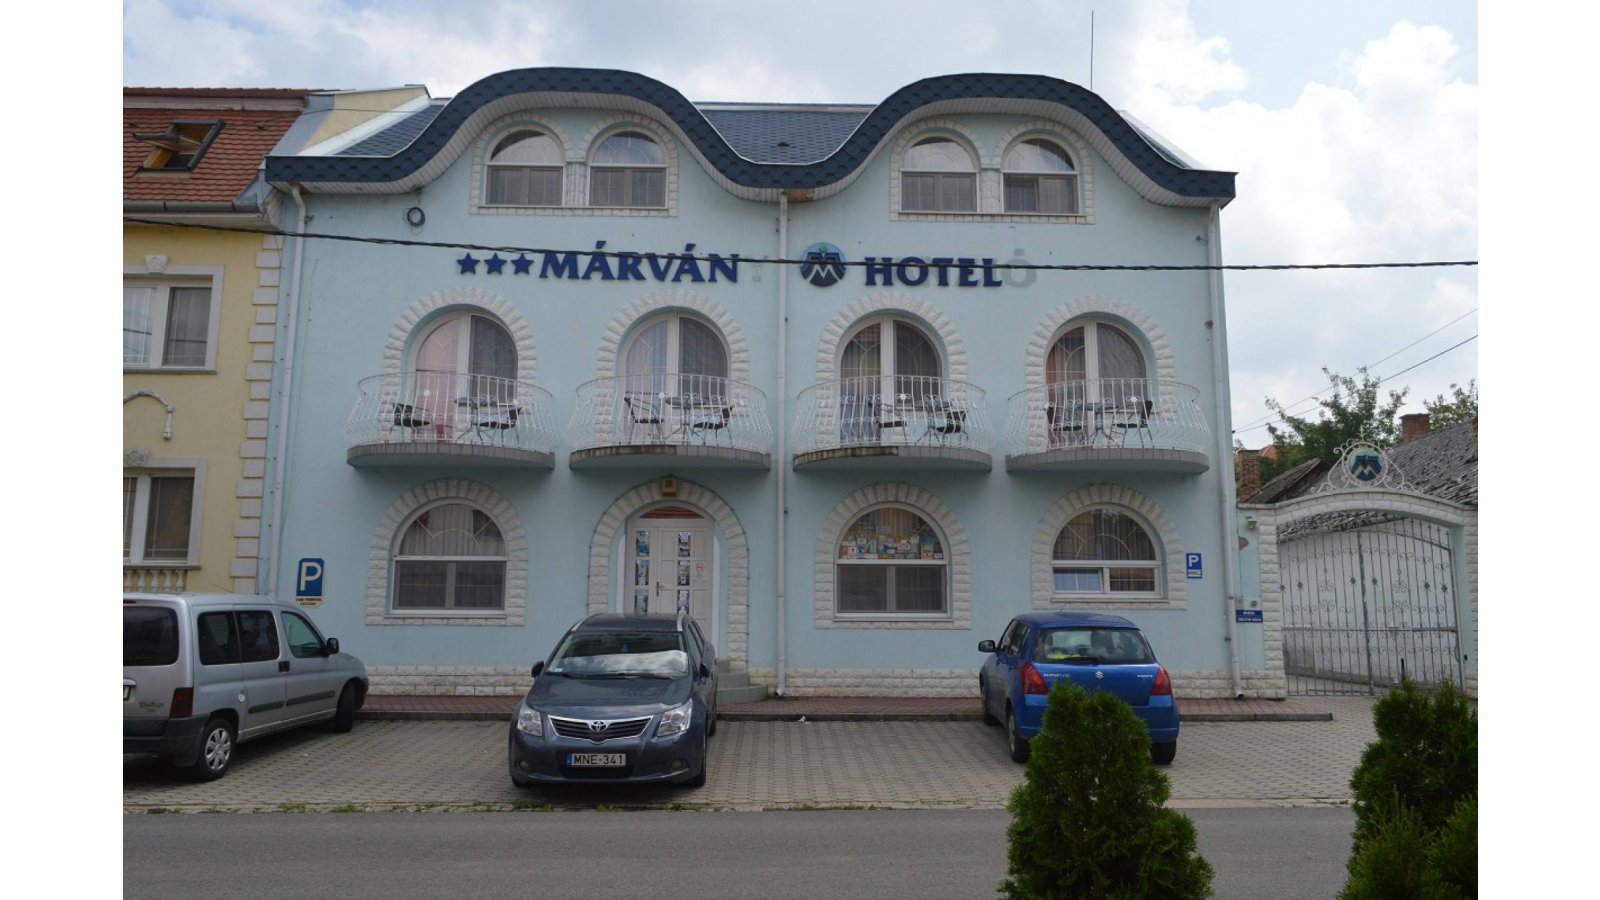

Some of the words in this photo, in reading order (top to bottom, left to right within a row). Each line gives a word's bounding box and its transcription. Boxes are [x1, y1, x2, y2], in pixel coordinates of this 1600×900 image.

[539, 240, 739, 283] MÁRVÁN
[864, 256, 1003, 287] HOTEL
[1188, 554, 1199, 568] P
[300, 561, 322, 591] P
[573, 754, 626, 766] MNE-341
